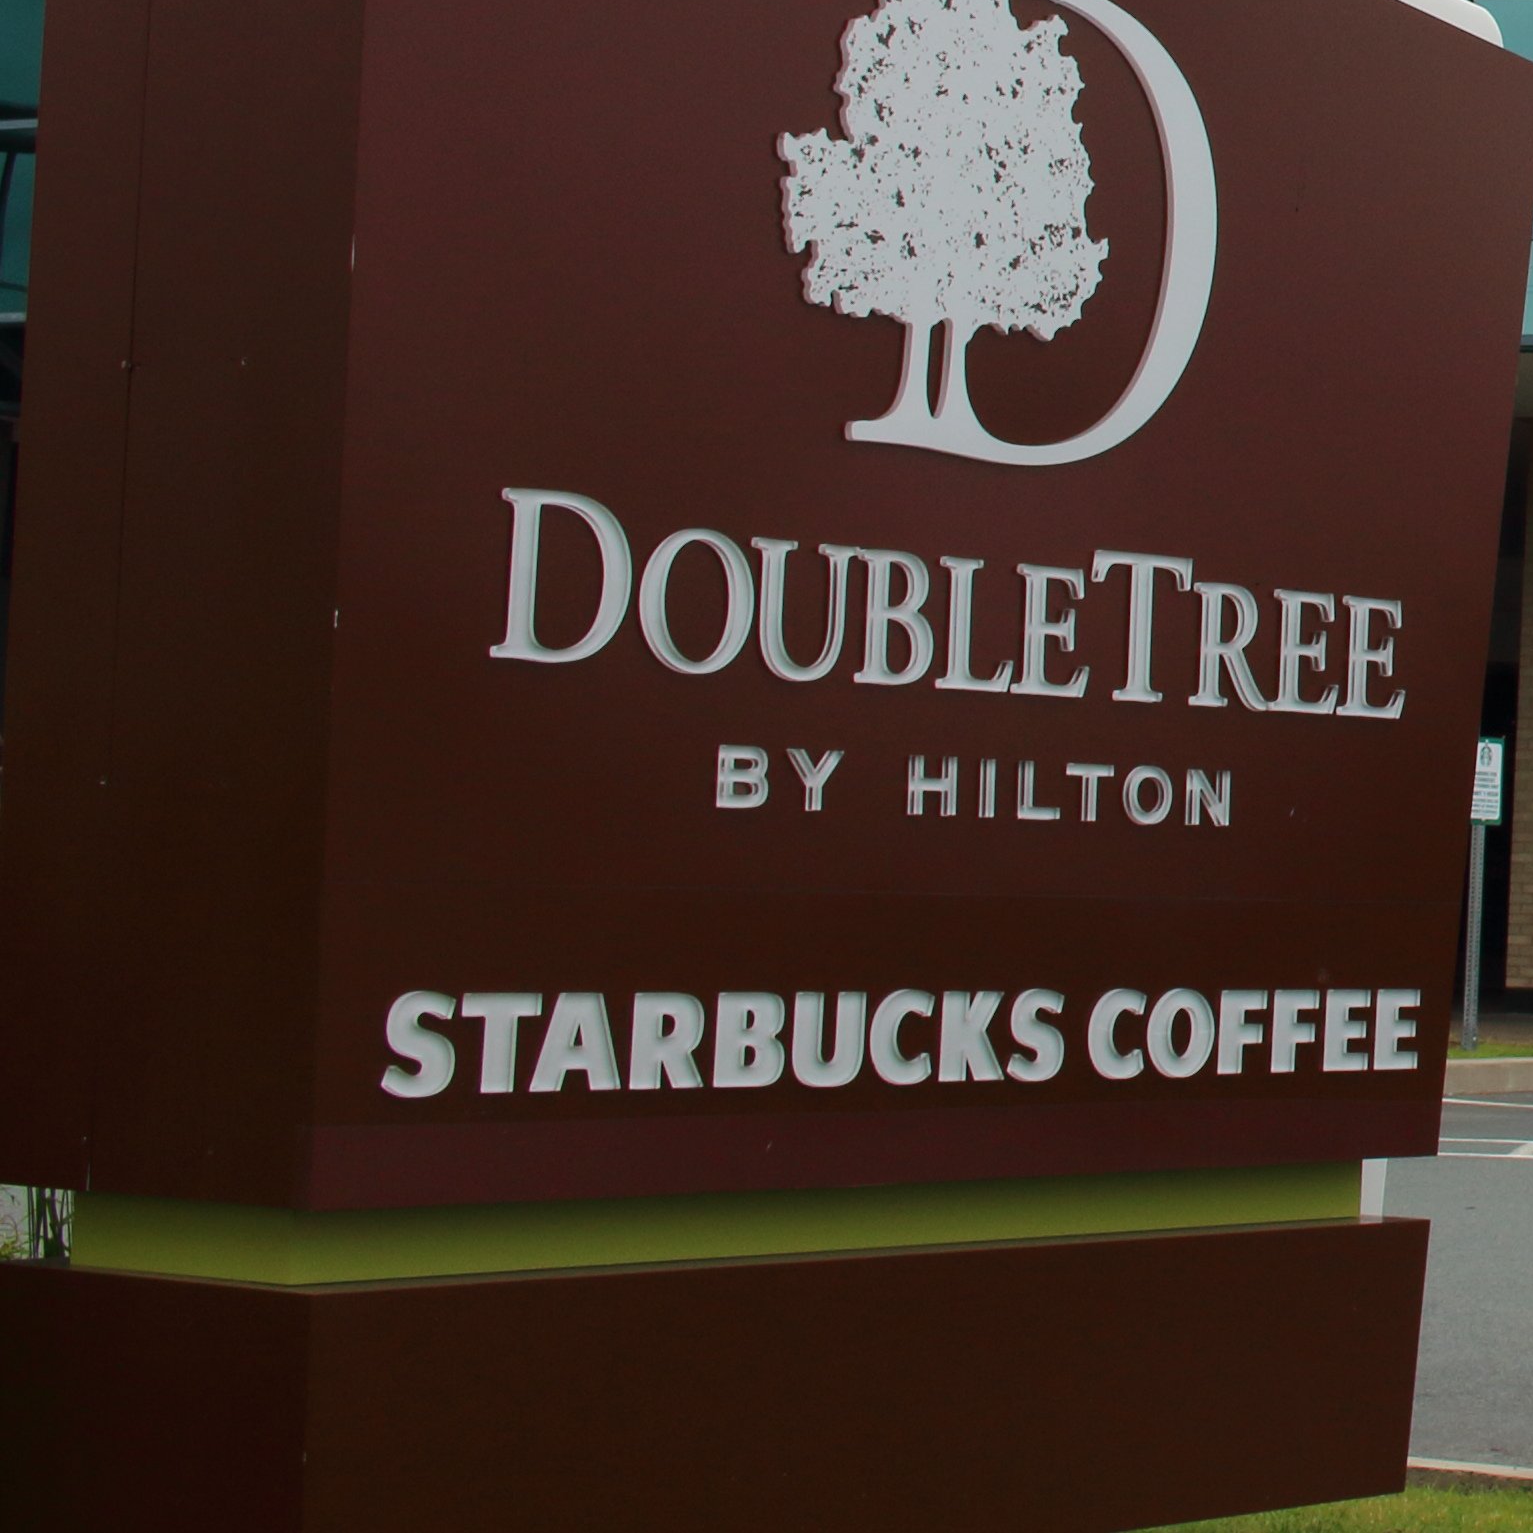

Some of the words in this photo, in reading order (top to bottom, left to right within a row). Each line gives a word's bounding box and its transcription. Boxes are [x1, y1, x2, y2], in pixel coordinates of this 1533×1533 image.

[489, 486, 1407, 719] DOUBLETREE
[715, 744, 845, 811] BY
[906, 755, 1232, 827] HILTON
[380, 989, 1066, 1099] STARBUCKS
[1087, 987, 1422, 1079] COFFEE
